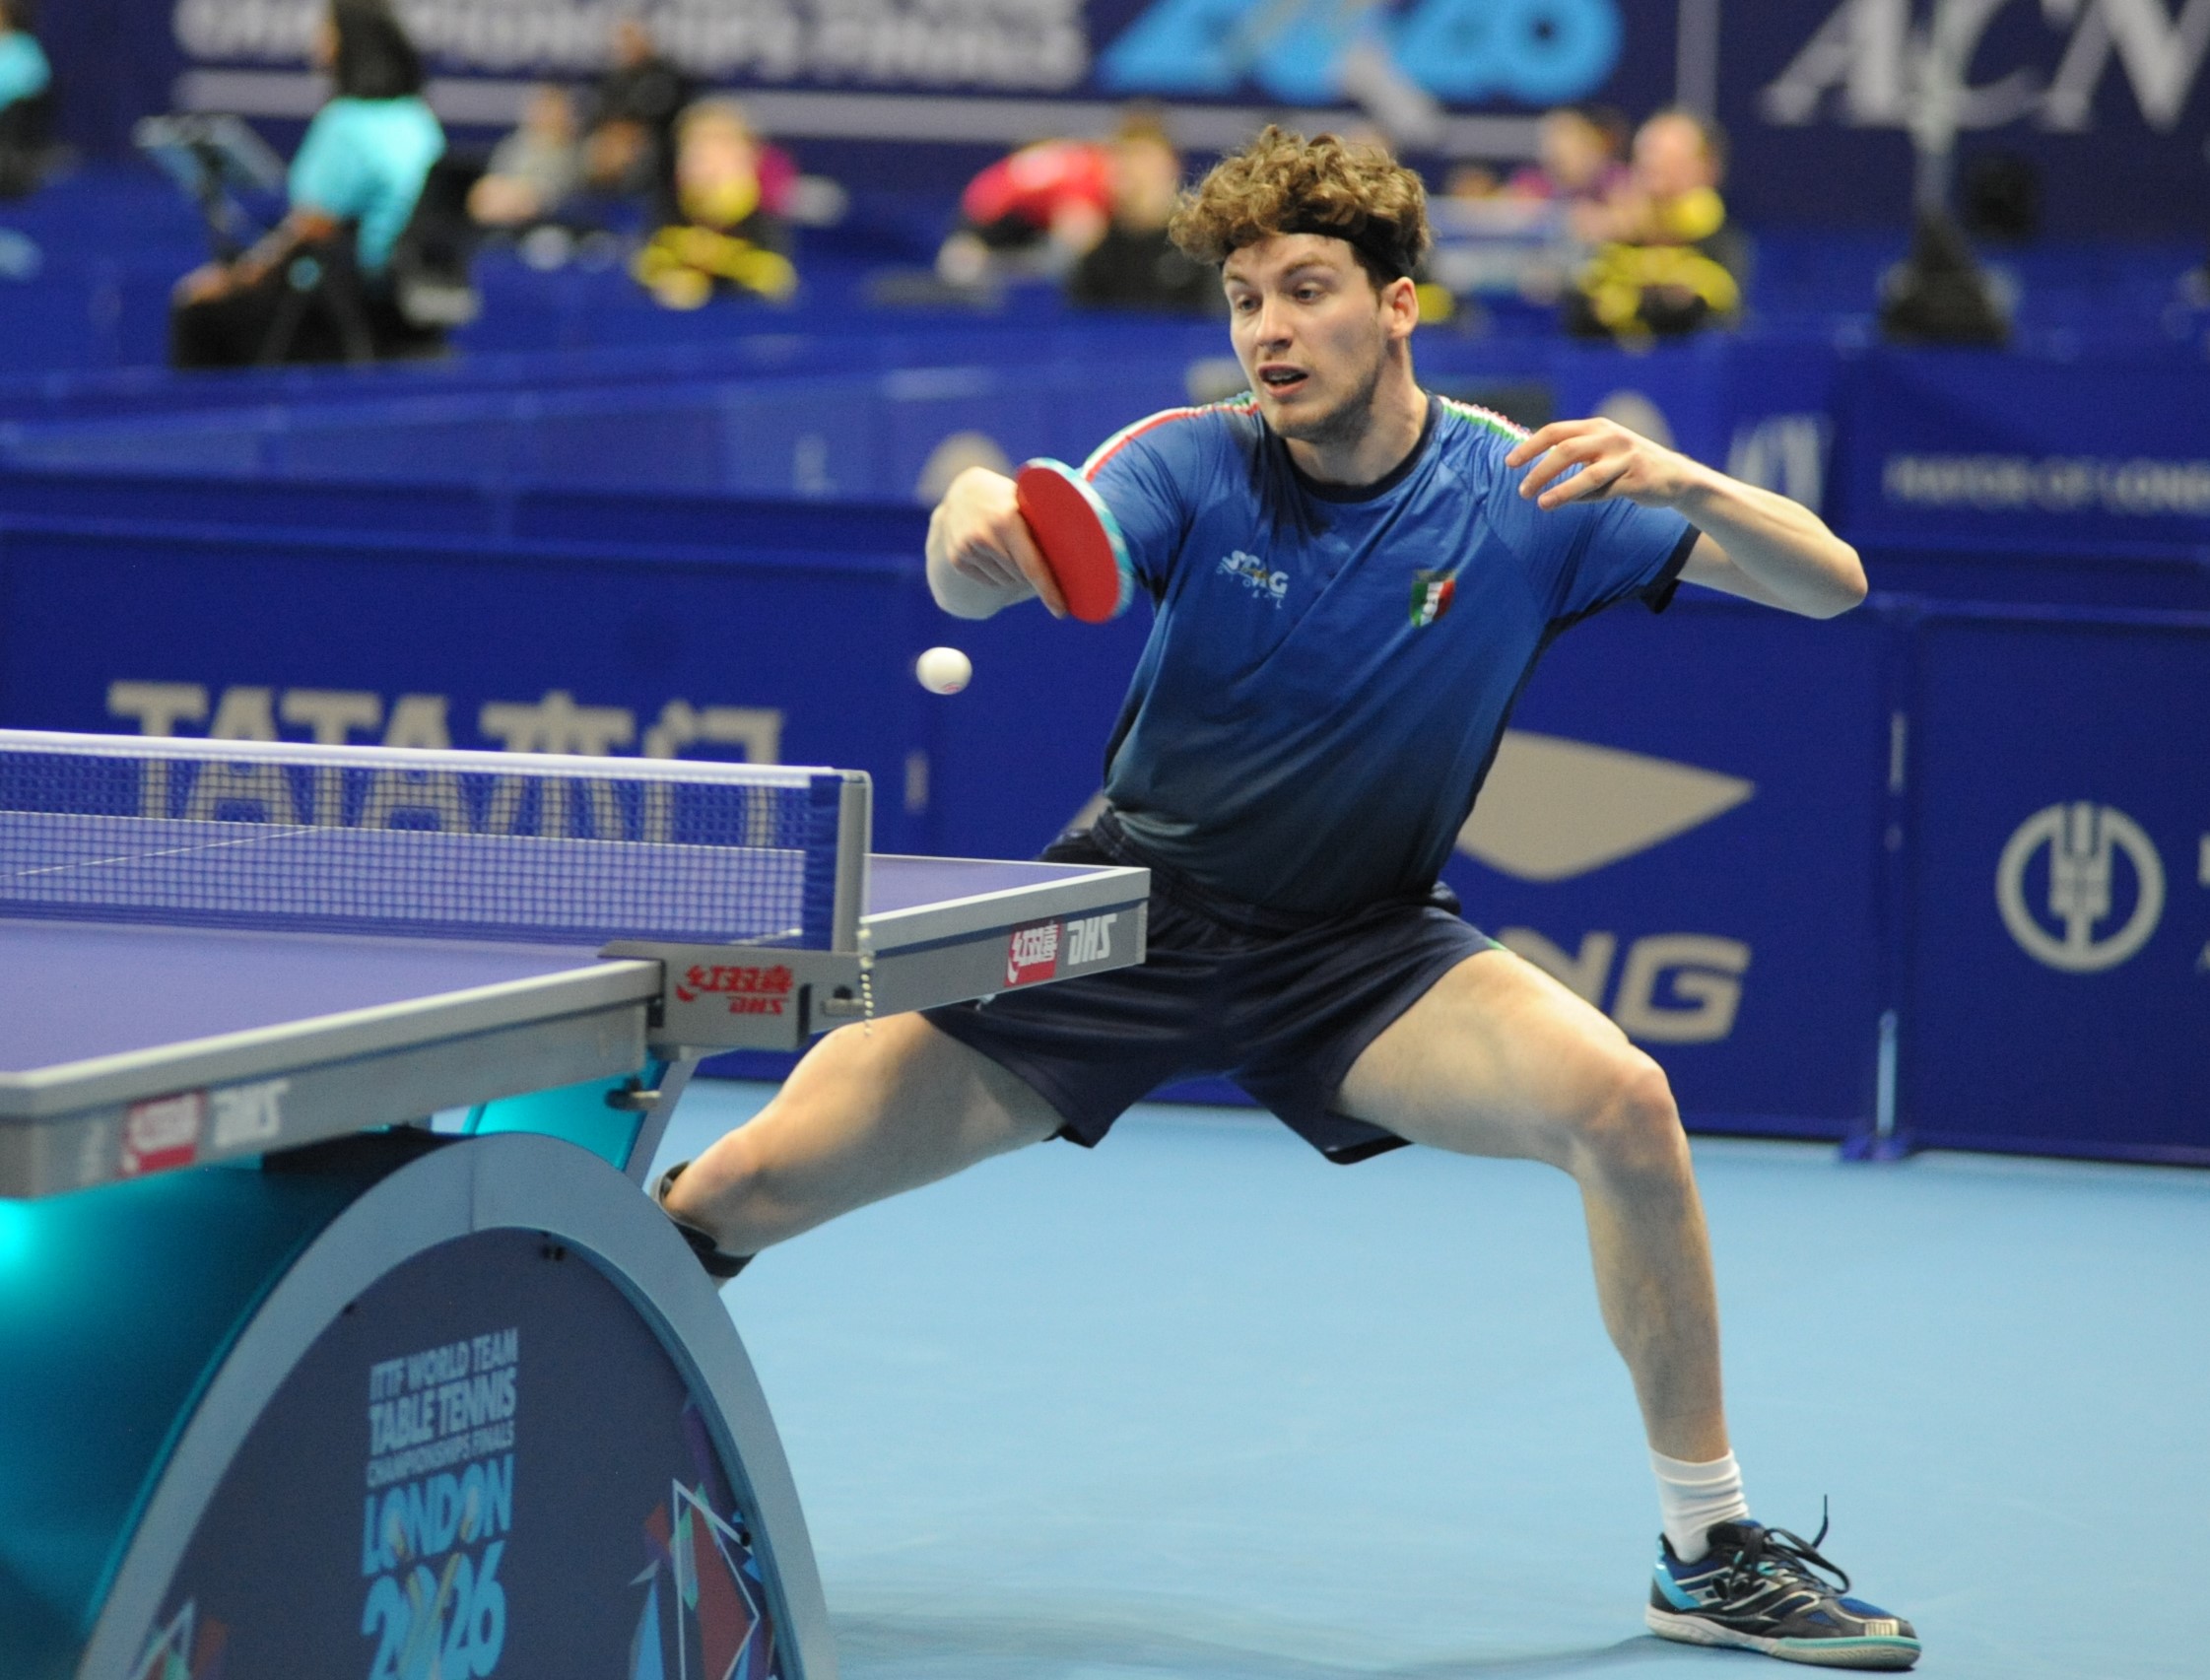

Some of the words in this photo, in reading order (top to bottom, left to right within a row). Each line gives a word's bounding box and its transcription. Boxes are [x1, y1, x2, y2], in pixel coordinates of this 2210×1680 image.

[1067, 912, 1117, 966] DHS
[1495, 924, 1752, 1044] NG
[368, 1358, 407, 1407] ITTF
[406, 1340, 469, 1391] WORLD
[470, 1327, 518, 1374] TEAM
[368, 1388, 436, 1457] TABLE
[437, 1366, 517, 1437] TENNIS
[362, 1452, 514, 1576] LONDON
[361, 1539, 506, 1680] 2026
